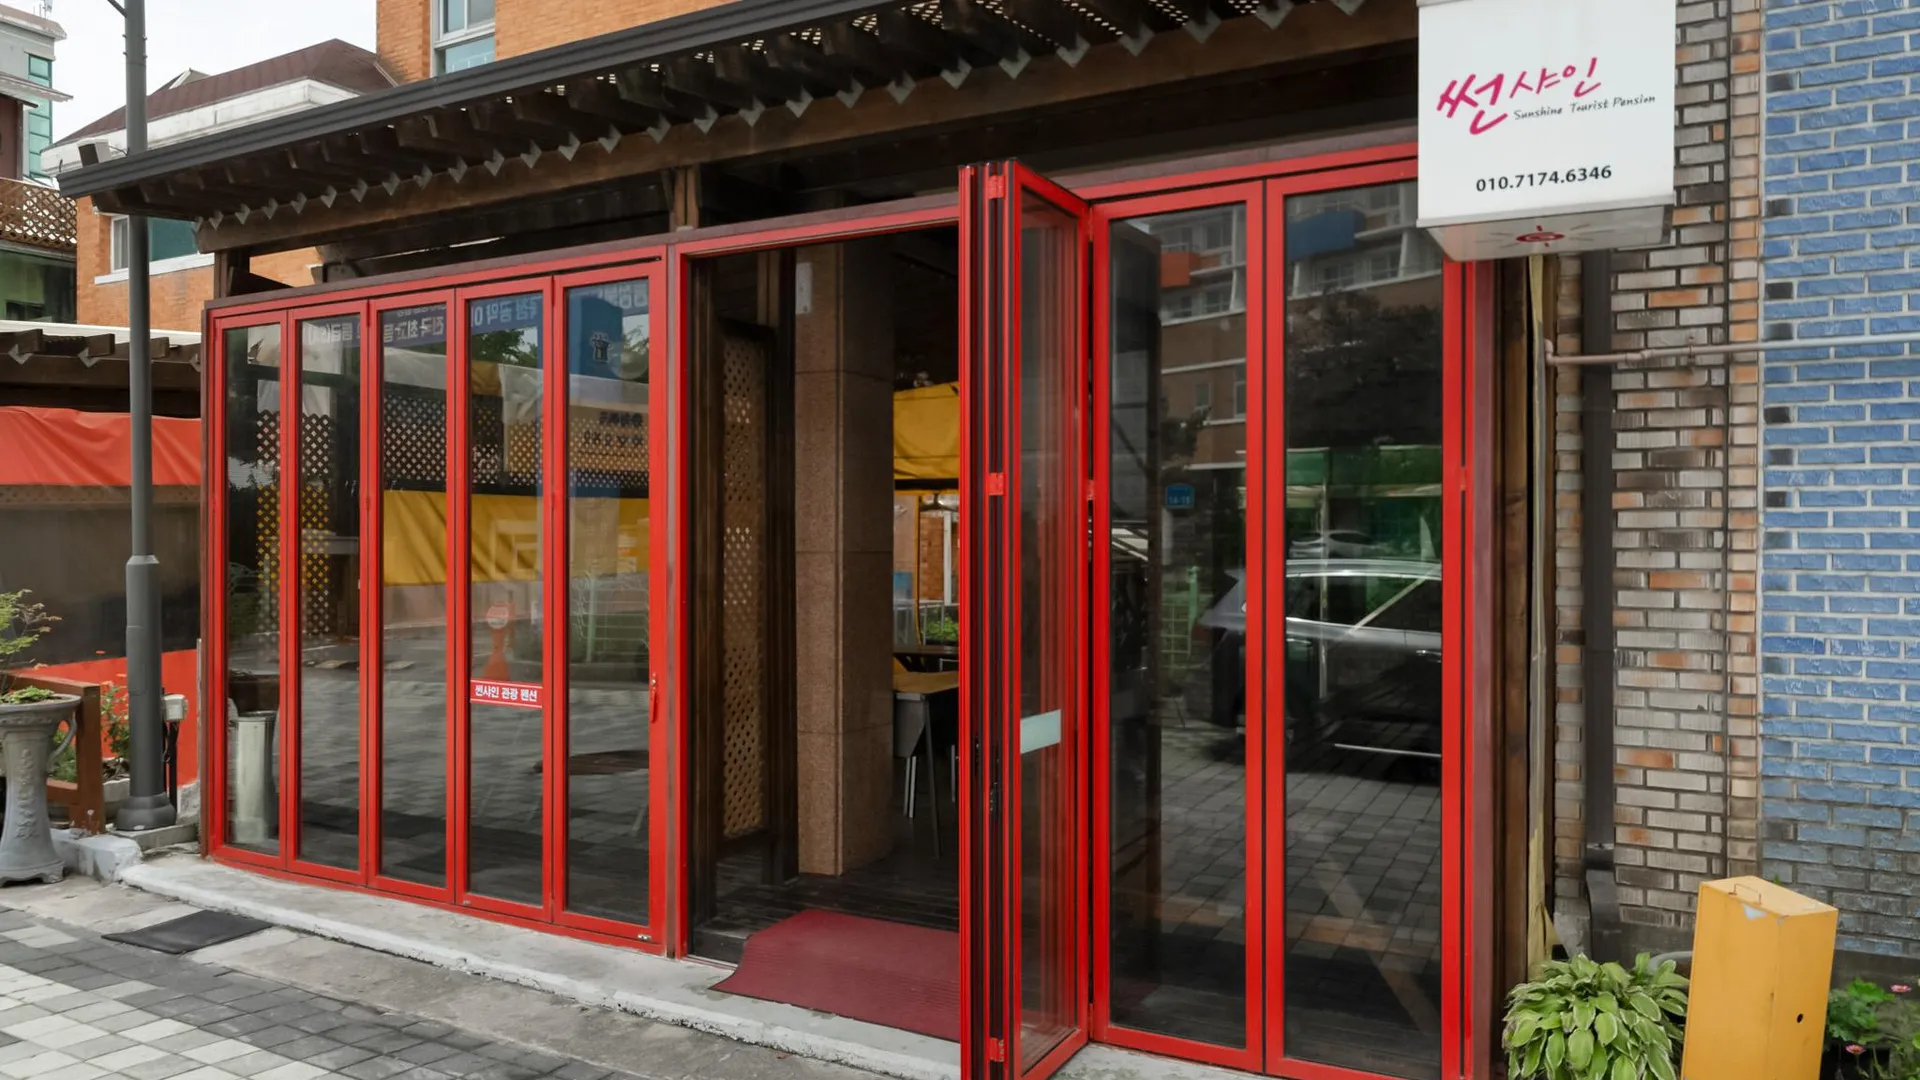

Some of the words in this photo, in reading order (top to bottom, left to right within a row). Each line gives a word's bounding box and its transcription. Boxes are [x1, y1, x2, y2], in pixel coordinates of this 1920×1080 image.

[1436, 57, 1602, 135] 썬샤인
[1514, 106, 1563, 120] Sunshine
[1570, 98, 1609, 113] Tourist
[1612, 94, 1656, 108] Pension
[1476, 165, 1612, 192] 010.7174.6346
